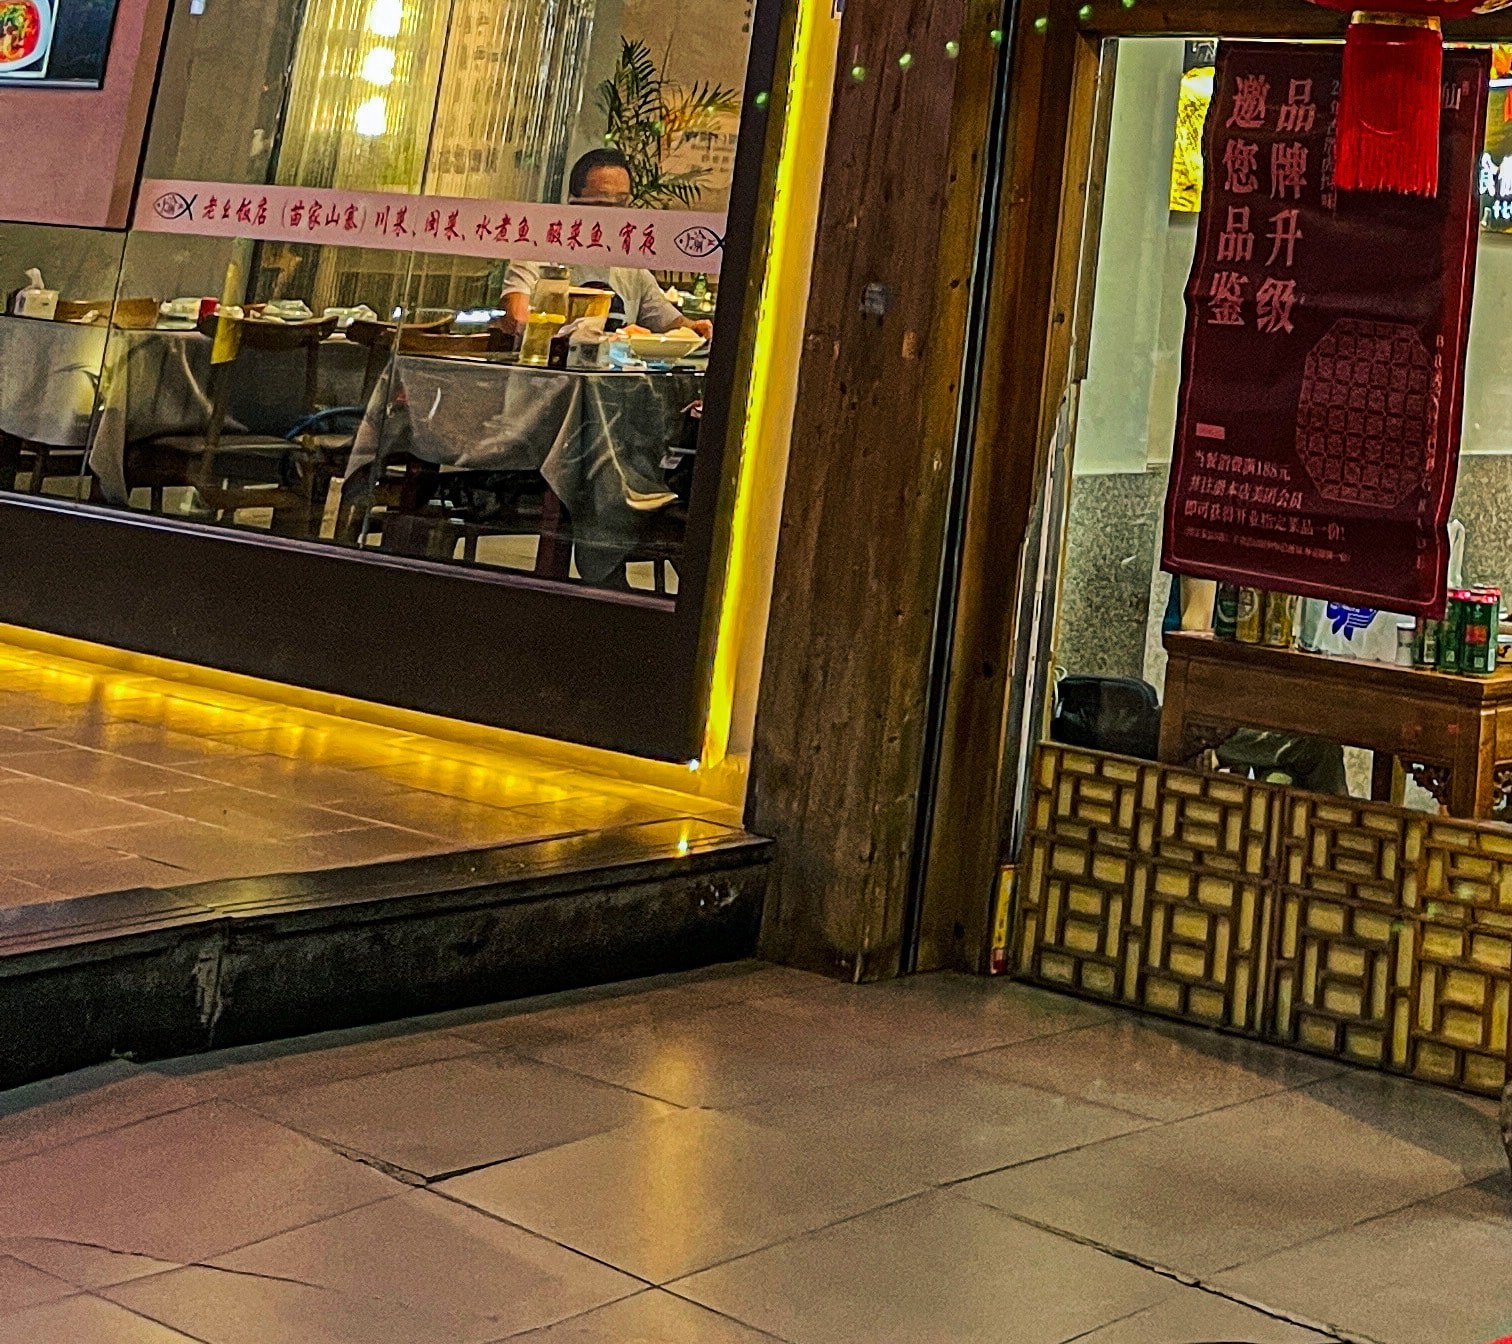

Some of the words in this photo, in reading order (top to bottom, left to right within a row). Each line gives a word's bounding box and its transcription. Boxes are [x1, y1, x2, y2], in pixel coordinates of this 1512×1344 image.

[1206, 74, 1267, 328] 邀您品鉴
[1254, 78, 1315, 334] 品牌升级
